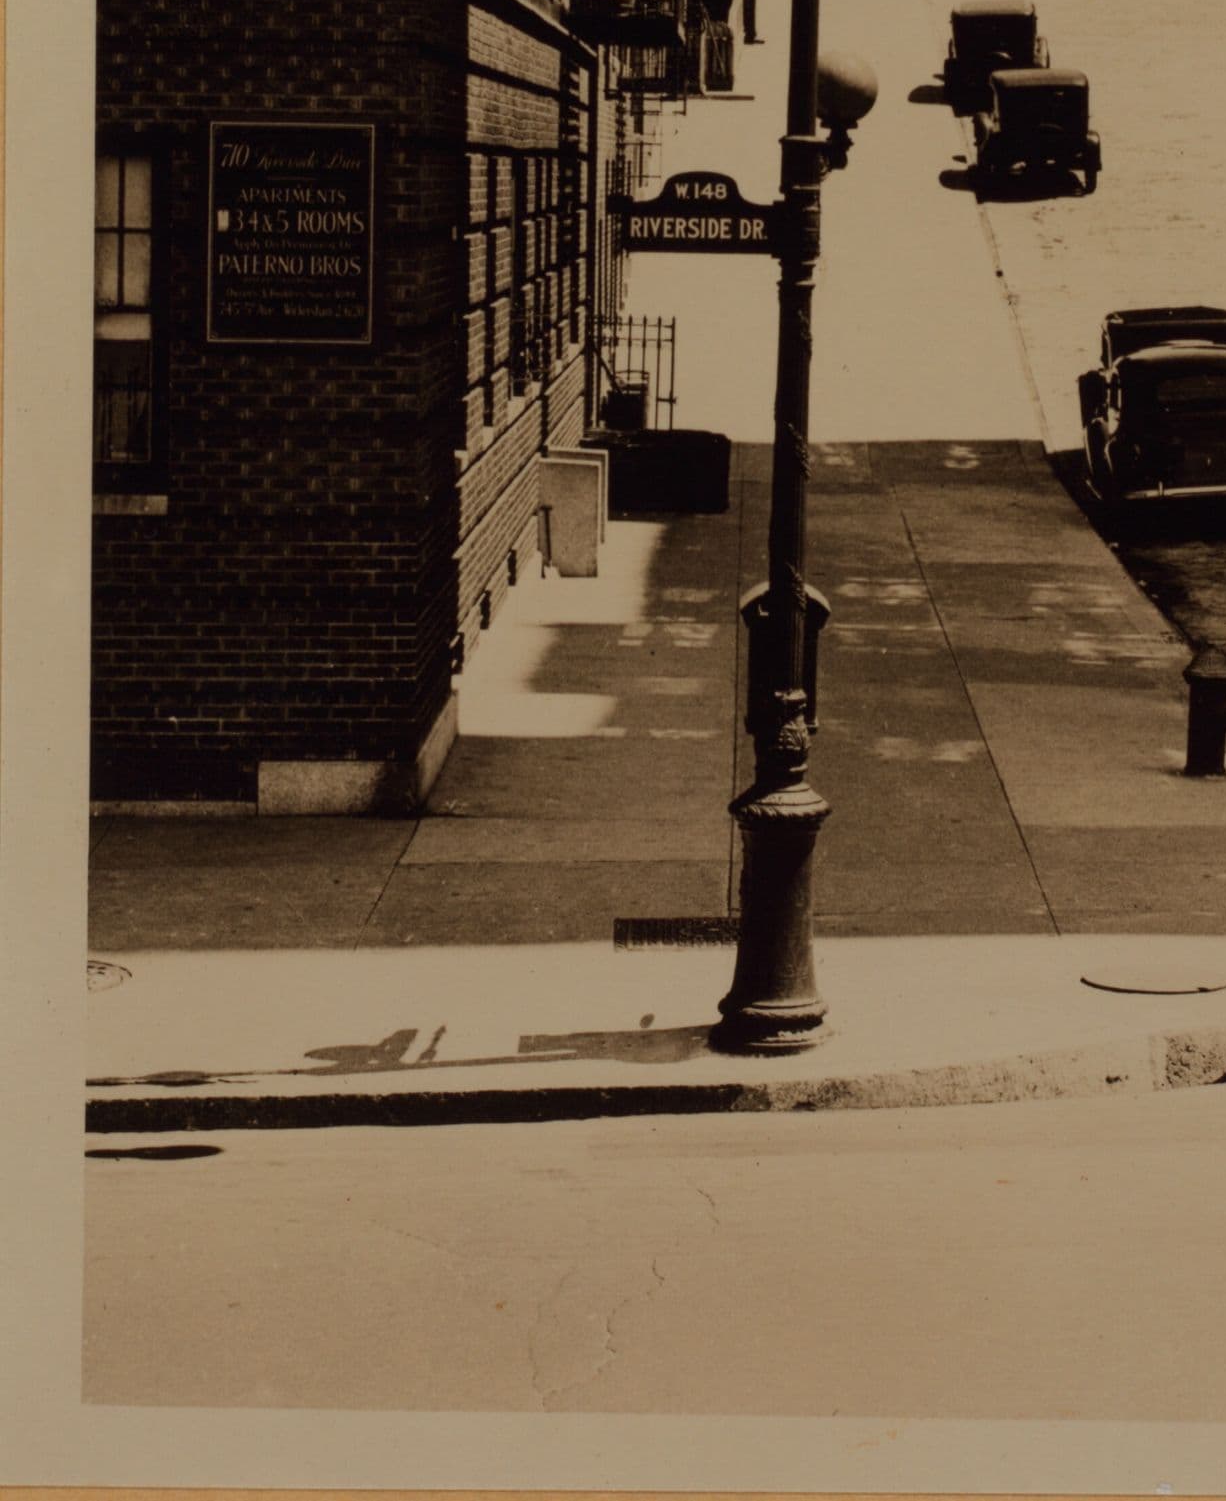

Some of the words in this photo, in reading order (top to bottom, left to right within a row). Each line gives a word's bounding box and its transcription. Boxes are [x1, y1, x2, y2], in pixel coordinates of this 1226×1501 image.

[220, 143, 250, 169] 710
[238, 186, 347, 204] APARTMENTS
[297, 209, 366, 235] ROOMS
[629, 216, 733, 240] RIVERSIDE
[738, 217, 769, 241] DR.
[218, 252, 305, 276] PATERNO
[310, 254, 362, 277] BROS
